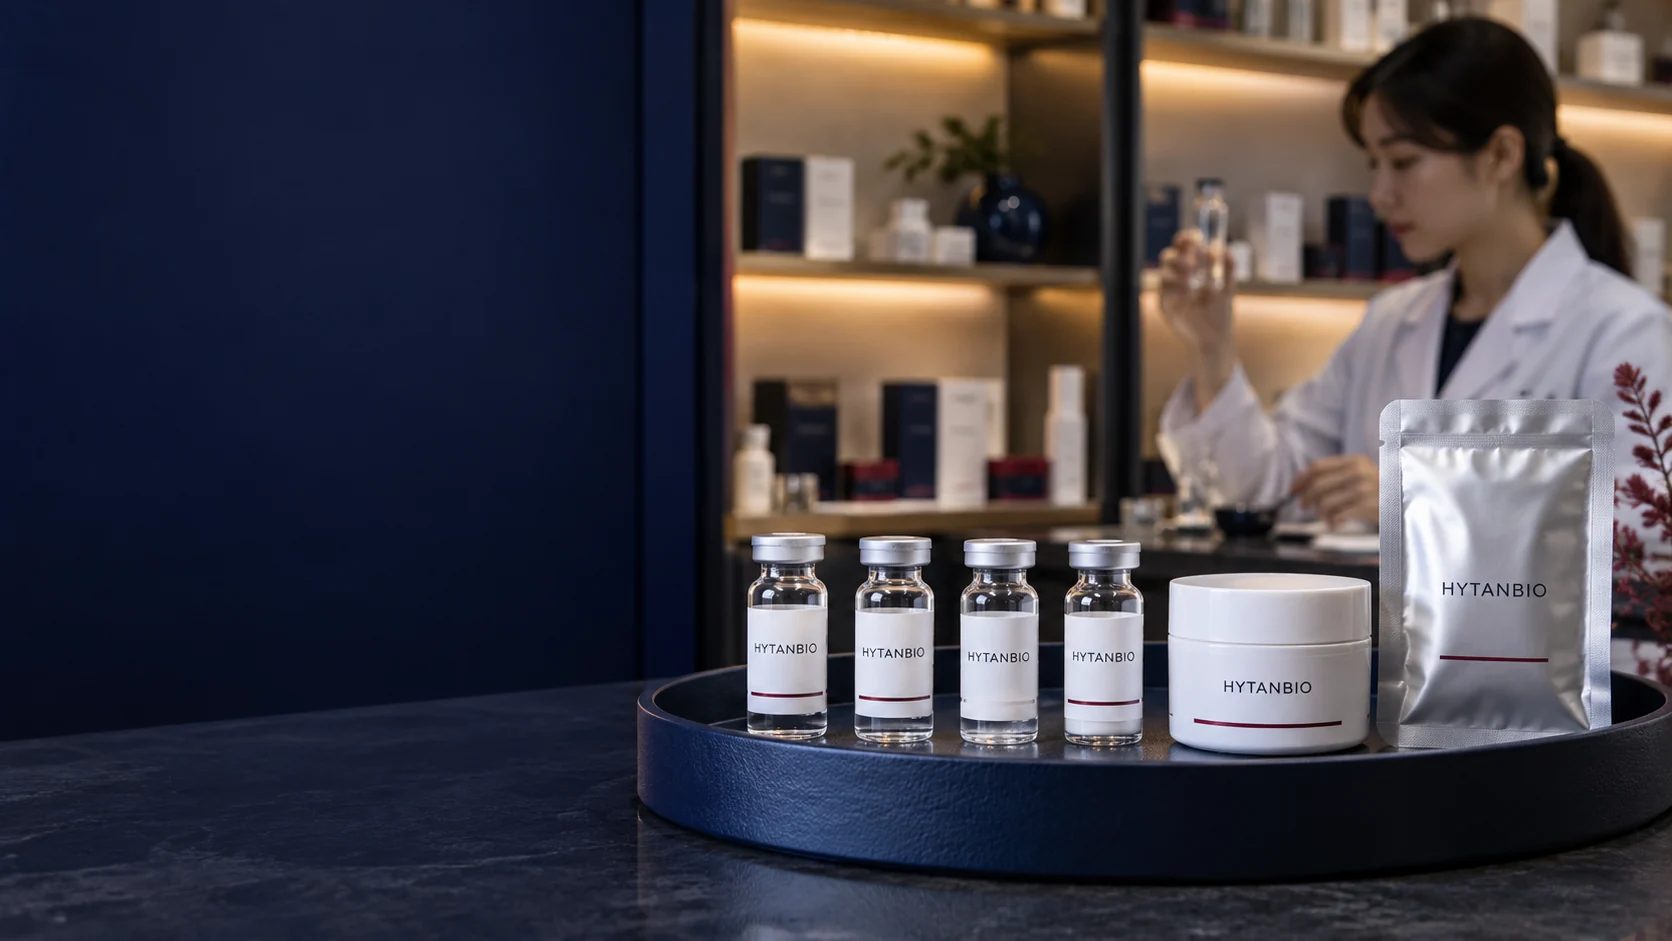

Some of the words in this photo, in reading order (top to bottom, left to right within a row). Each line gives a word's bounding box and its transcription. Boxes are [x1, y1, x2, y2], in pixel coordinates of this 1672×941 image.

[1441, 581, 1548, 598] HYTANBIO
[754, 642, 818, 655] HYTANBIO
[862, 646, 926, 659] HYTANBIO
[967, 651, 1030, 664] HYTANBIO
[1072, 650, 1136, 663] HYTANBIO
[1223, 679, 1313, 696] HYTANBIO
